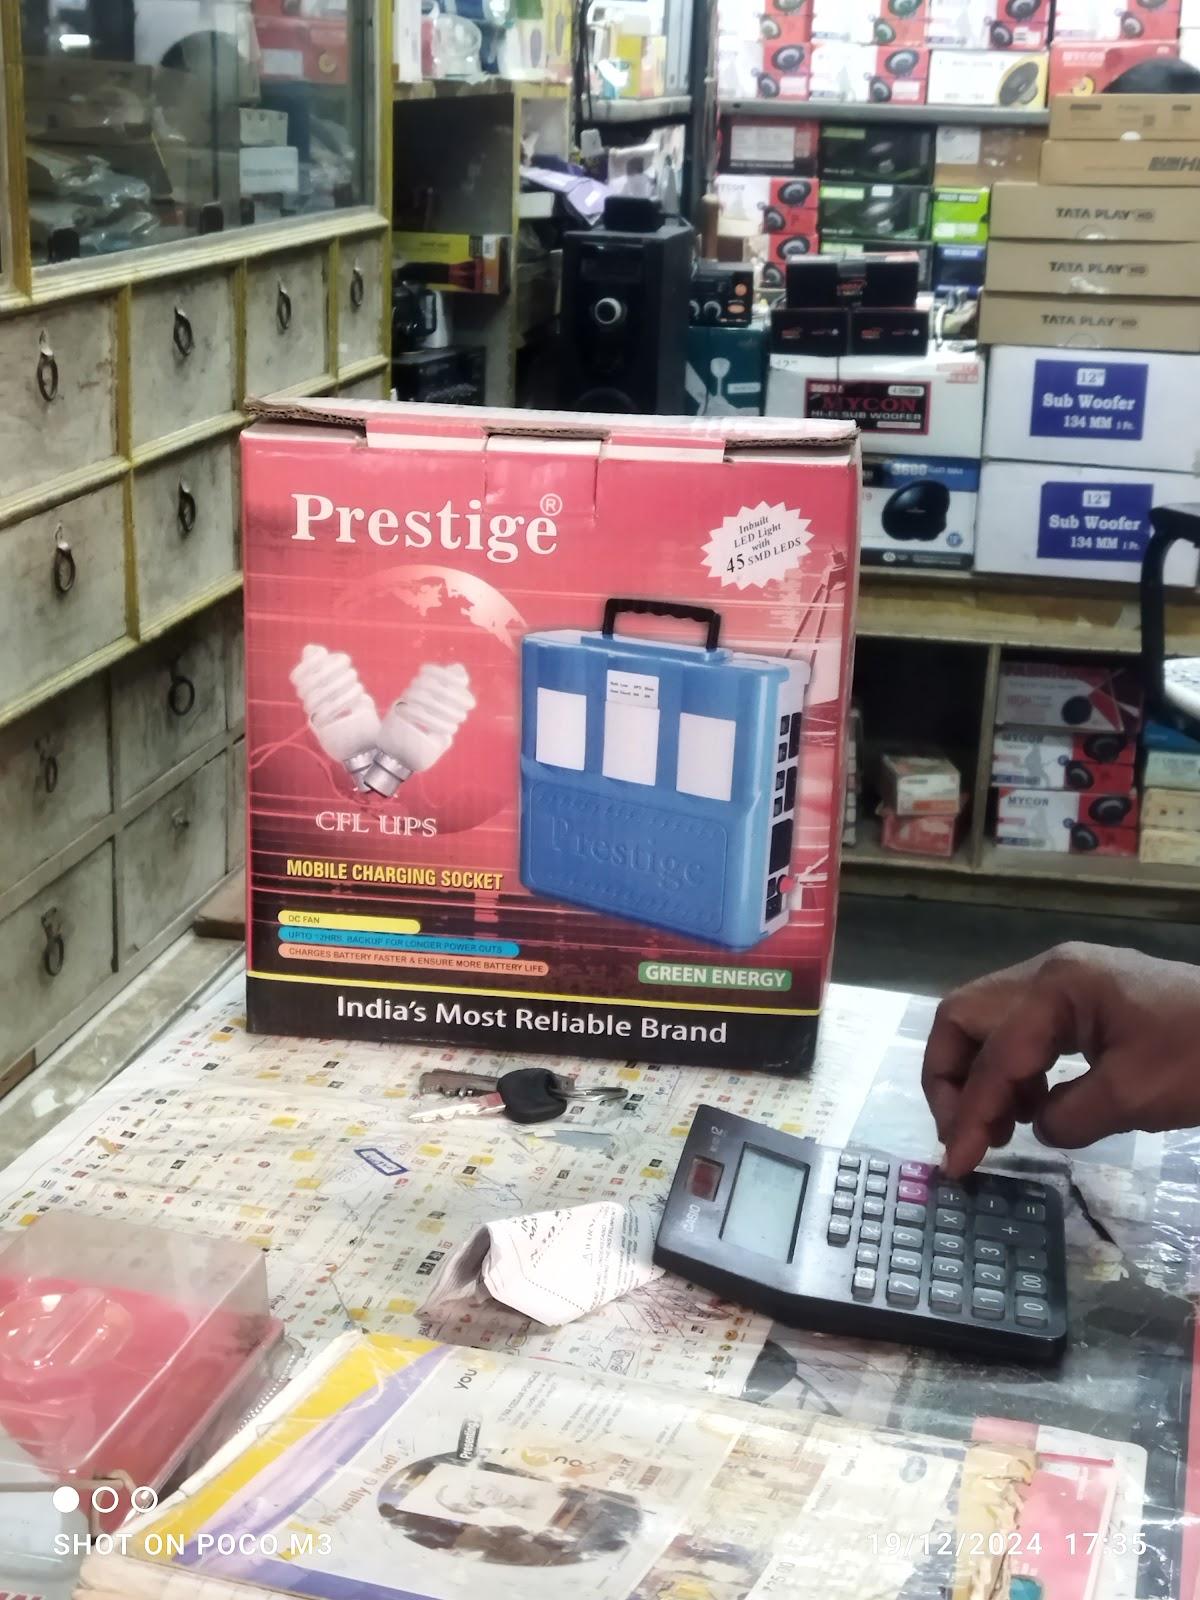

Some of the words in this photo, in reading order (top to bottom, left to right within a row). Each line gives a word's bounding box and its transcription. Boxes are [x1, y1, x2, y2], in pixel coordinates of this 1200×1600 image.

[1056, 207, 1091, 219] TATA
[1094, 209, 1131, 220] PLAY
[1049, 261, 1084, 273] TATA
[1088, 263, 1125, 274] PLAY
[1041, 314, 1076, 326] TATA
[1080, 316, 1116, 327] PLAY
[1042, 393, 1073, 408] Sub
[1078, 394, 1136, 411] Woofer
[842, 411, 867, 419] SUB
[870, 412, 922, 420] WOOFER
[1063, 415, 1087, 428] 134
[1089, 416, 1112, 430] MM
[291, 493, 558, 564] Prestige
[738, 516, 770, 534] Inbuilt
[1049, 514, 1080, 529] Sub
[1084, 515, 1142, 531] Woofer
[733, 533, 756, 549] LED
[757, 522, 782, 538] Light
[751, 539, 771, 552] with
[1070, 536, 1093, 549] 134
[1096, 537, 1118, 550] MM
[726, 553, 746, 574] 45
[747, 550, 772, 567] SMD
[773, 536, 802, 557] LEDS
[315, 811, 370, 834] CFL
[379, 815, 437, 838] UPS
[550, 815, 704, 891] Prestige
[286, 859, 348, 881] MOBILE
[351, 865, 436, 886] CHARGING
[440, 871, 504, 890] SOCKET
[288, 914, 301, 923] DC
[303, 915, 320, 924] FAN
[288, 931, 313, 940] UPTO
[347, 935, 384, 945] BACKUP
[386, 937, 404, 946] FOR
[405, 940, 442, 949] LONGER
[444, 942, 476, 952] POWER
[478, 945, 503, 954] CUTS
[289, 947, 332, 958] CHARGES
[334, 950, 372, 961] BATTERY
[374, 953, 407, 963] FASTER
[417, 957, 455, 967] ENSURE
[456, 960, 482, 969] MORE
[483, 961, 523, 971] BATTERY
[525, 964, 544, 973] LIFE
[645, 965, 707, 984] GREEN
[711, 969, 787, 989] ENERGY
[337, 995, 427, 1023] India's
[435, 1003, 507, 1028] Most
[516, 1009, 633, 1038] Reliable
[641, 1018, 728, 1045] Brand
[903, 1185, 922, 1196] C
[683, 1204, 701, 1233] CASIO
[897, 1232, 917, 1242] 9
[940, 1240, 960, 1250] 6
[980, 1245, 1001, 1257] 3
[895, 1256, 917, 1267] 8
[939, 1264, 960, 1274] 5
[980, 1271, 1001, 1282] 2
[1023, 1273, 1043, 1289] 00
[894, 1279, 914, 1291] 7
[937, 1288, 957, 1299] 4
[1023, 1301, 1045, 1312] 0
[458, 1419, 481, 1460] Presenting
